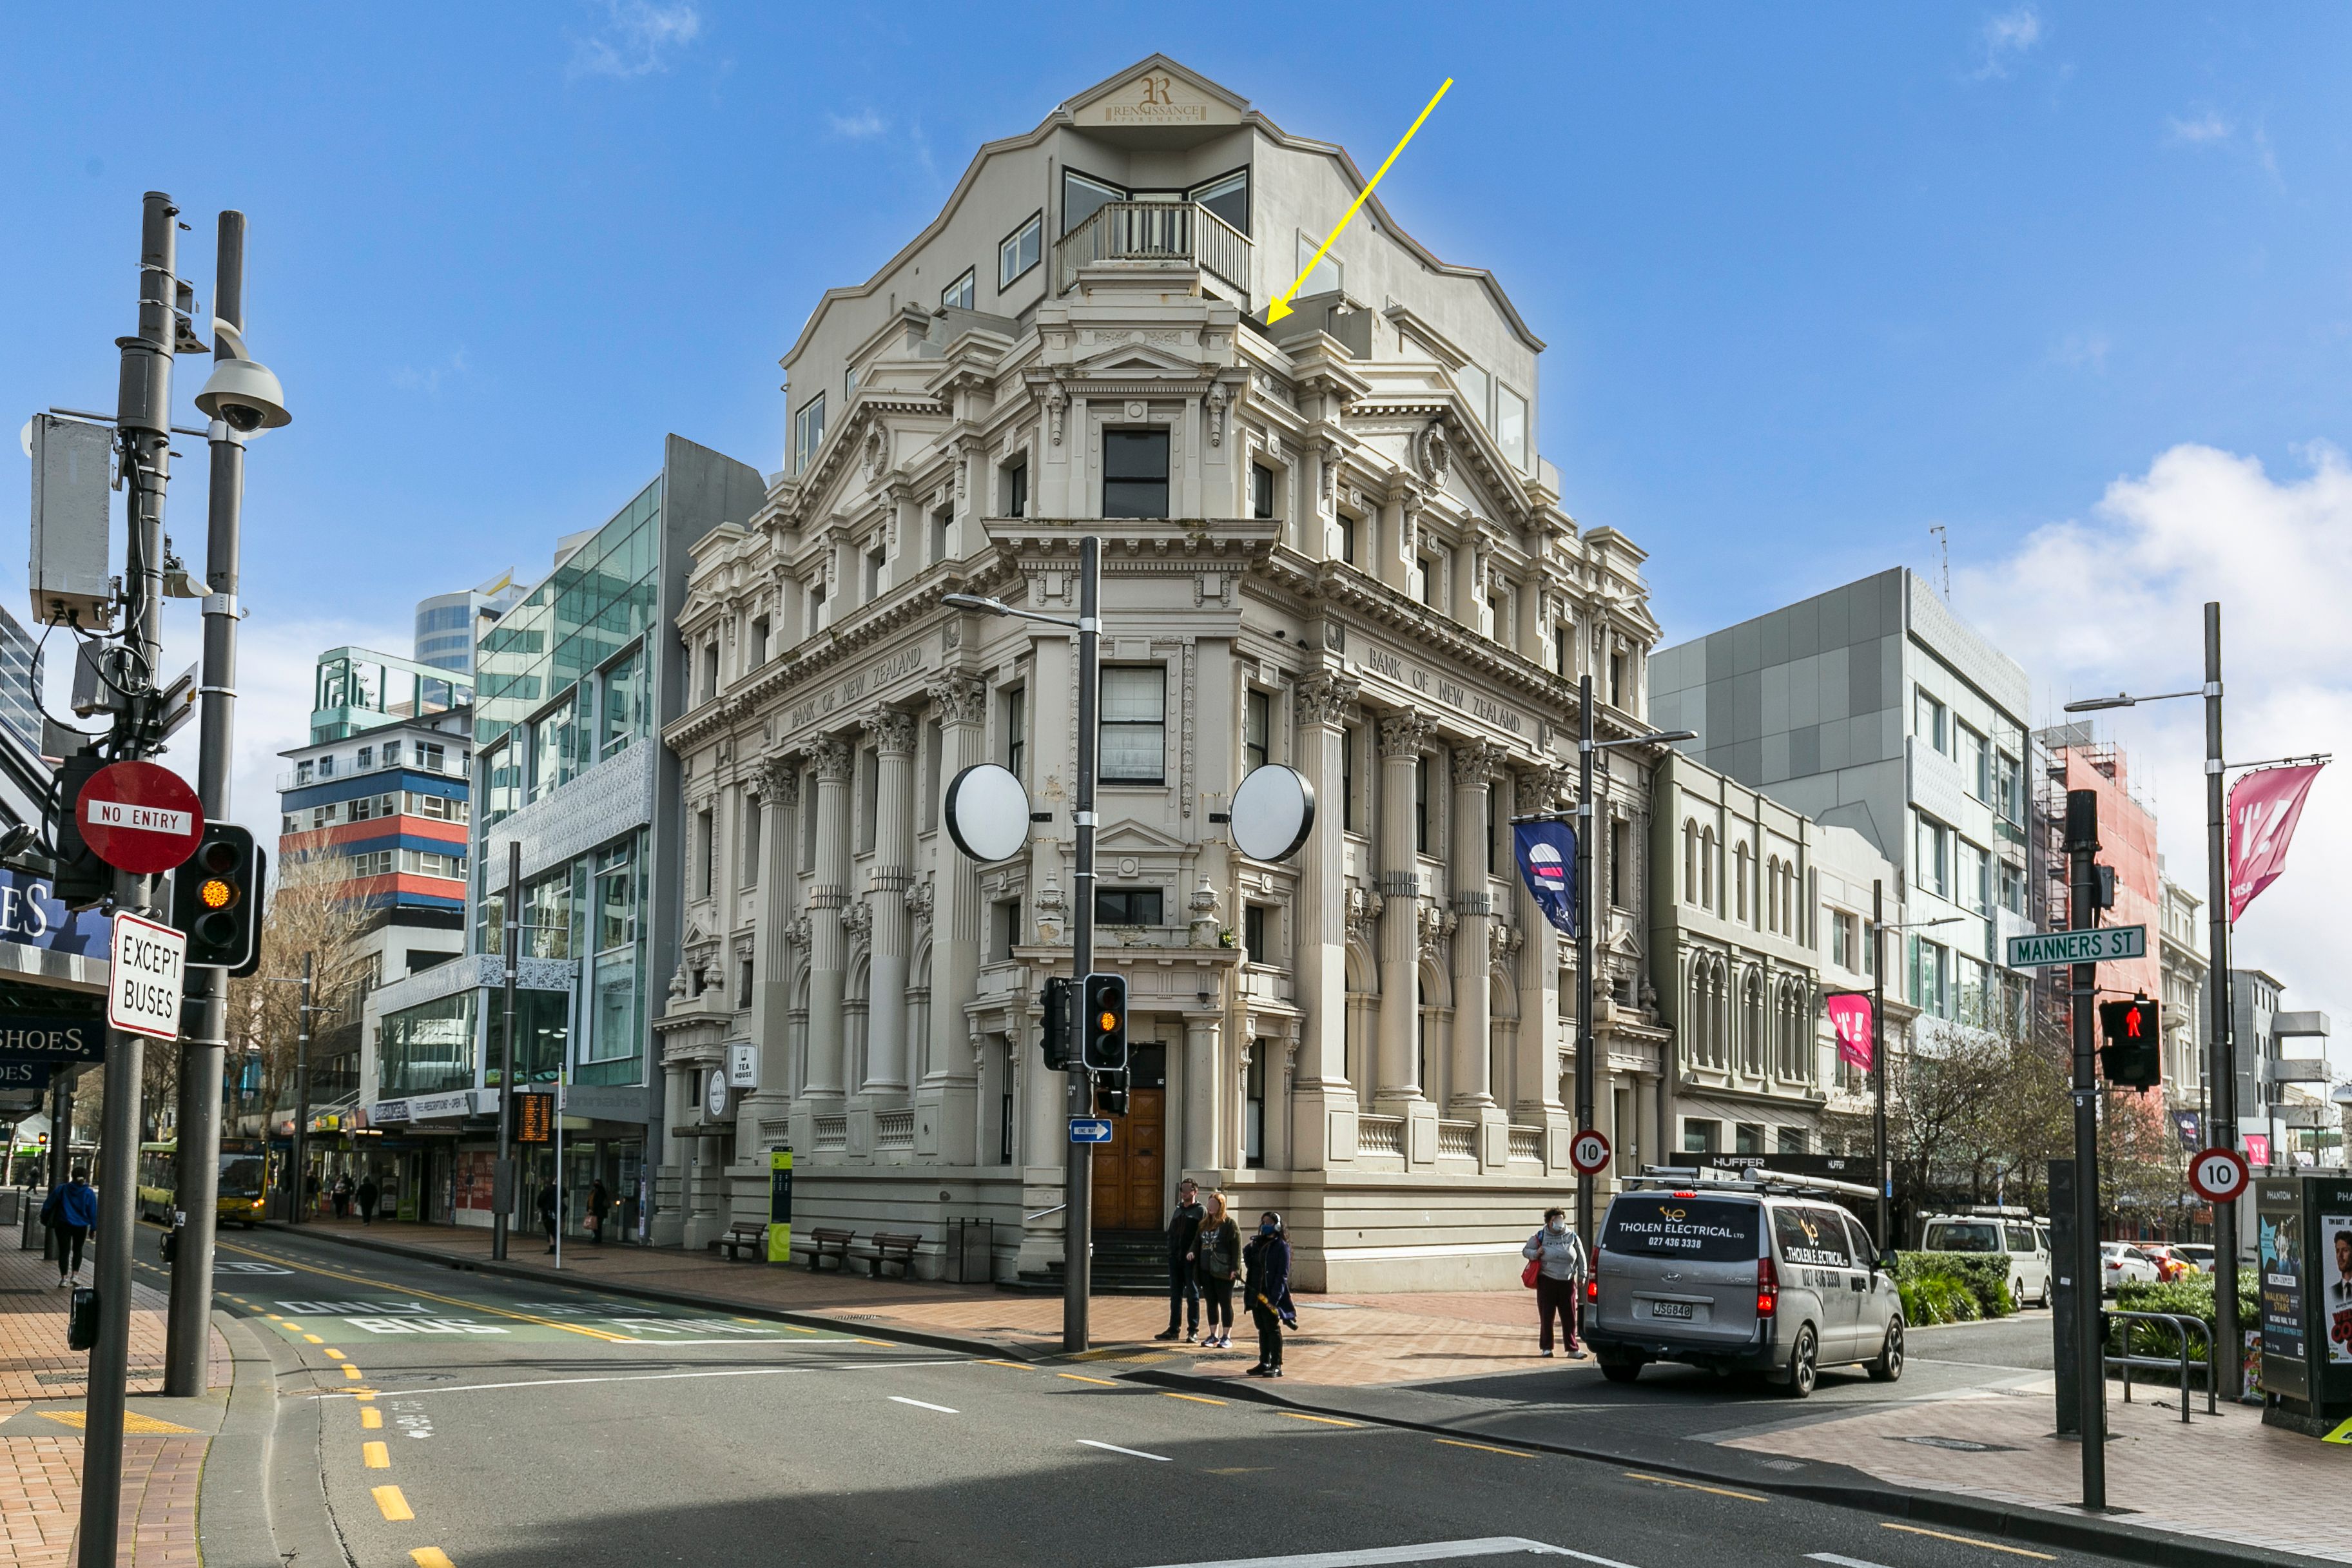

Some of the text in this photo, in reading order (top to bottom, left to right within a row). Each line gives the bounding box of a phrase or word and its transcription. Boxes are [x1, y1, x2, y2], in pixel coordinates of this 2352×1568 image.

[1114, 106, 1199, 116] RENAISSANCE
[792, 646, 921, 728] BANK OF NEW ZEALAND
[1369, 647, 1521, 733] BANK OF NEW ZEALAND
[102, 806, 179, 829] NO ENTRY
[2232, 881, 2253, 898] VISA
[2017, 931, 2133, 962] MANNERS ST
[122, 934, 180, 979] EXCEPT
[124, 979, 173, 1020] BUSES
[0, 1029, 83, 1051] HOES
[0, 1064, 32, 1081] ES
[2076, 1096, 2083, 1107] 5
[1582, 1143, 1599, 1161] 10
[1713, 1157, 1765, 1167] HUFFER
[1827, 1160, 1845, 1169] HUFFER
[2208, 1165, 2231, 1185] 10
[2266, 1190, 2291, 1200] PHANTOM
[1619, 1223, 1662, 1234] THOLEN
[1665, 1224, 1732, 1237] ELECTRICAL
[1649, 1236, 1702, 1249] 027 436 3338
[1786, 1246, 1812, 1263] THOLEN
[1812, 1250, 1843, 1266] EECTRICAL
[1802, 1269, 1841, 1288] 027 436 3338
[2264, 1290, 2289, 1303] WALKING
[273, 1301, 438, 1313] ONLY
[1655, 1302, 1690, 1316] JSG840
[2273, 1302, 2290, 1313] STARS
[343, 1318, 511, 1333] BUS
